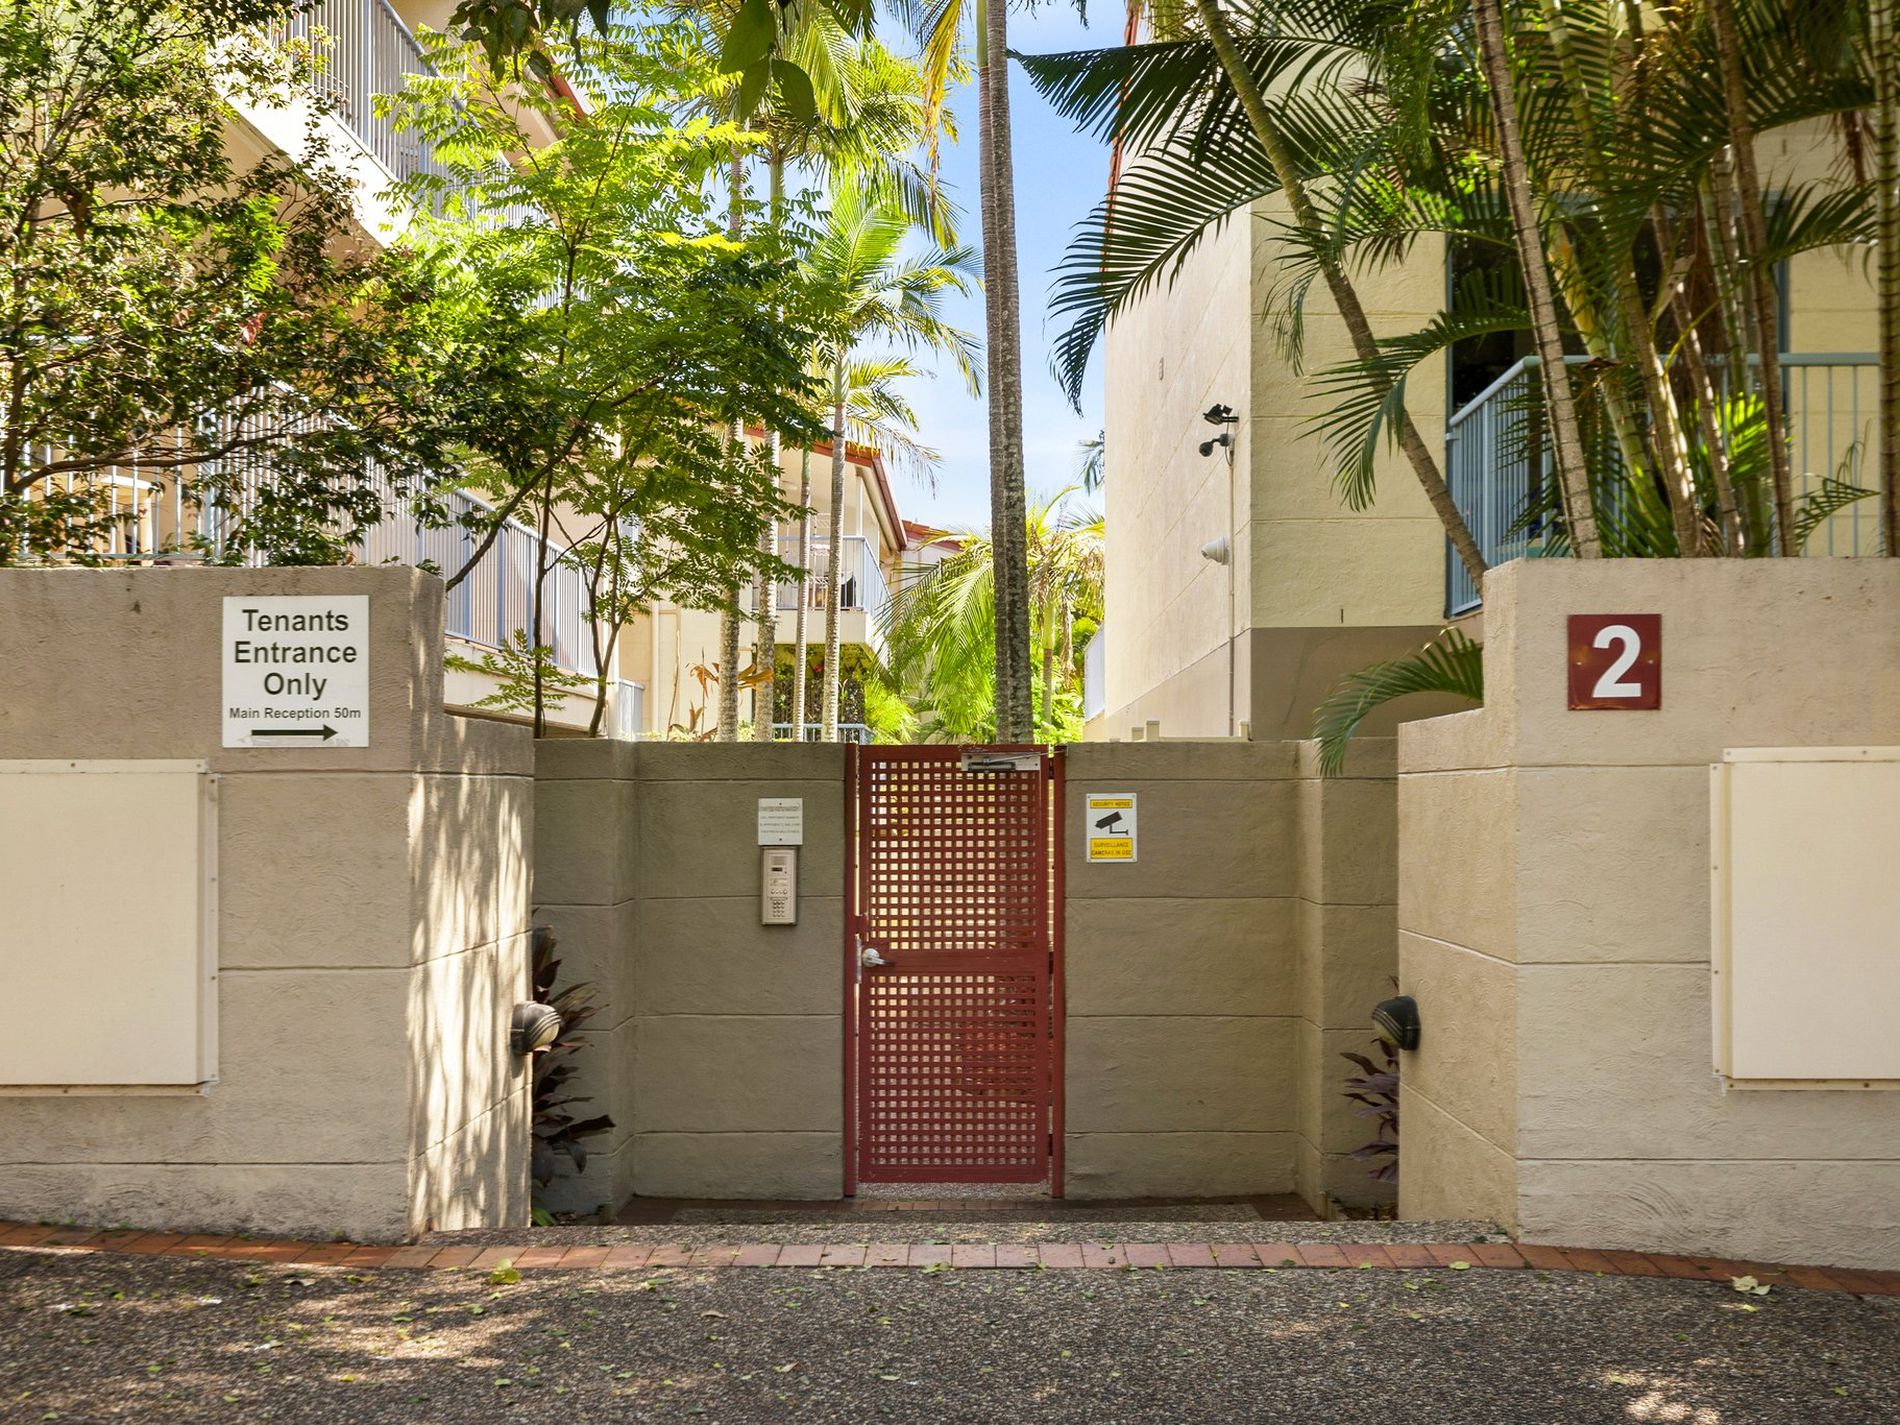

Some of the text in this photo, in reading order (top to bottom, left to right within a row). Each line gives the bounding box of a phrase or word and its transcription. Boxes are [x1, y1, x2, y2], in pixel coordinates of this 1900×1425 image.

[242, 609, 349, 632] Tenants
[235, 641, 357, 663] Entrance
[1592, 624, 1642, 698] 2
[264, 672, 327, 701] Only
[229, 708, 361, 721] Main Reception 50m
